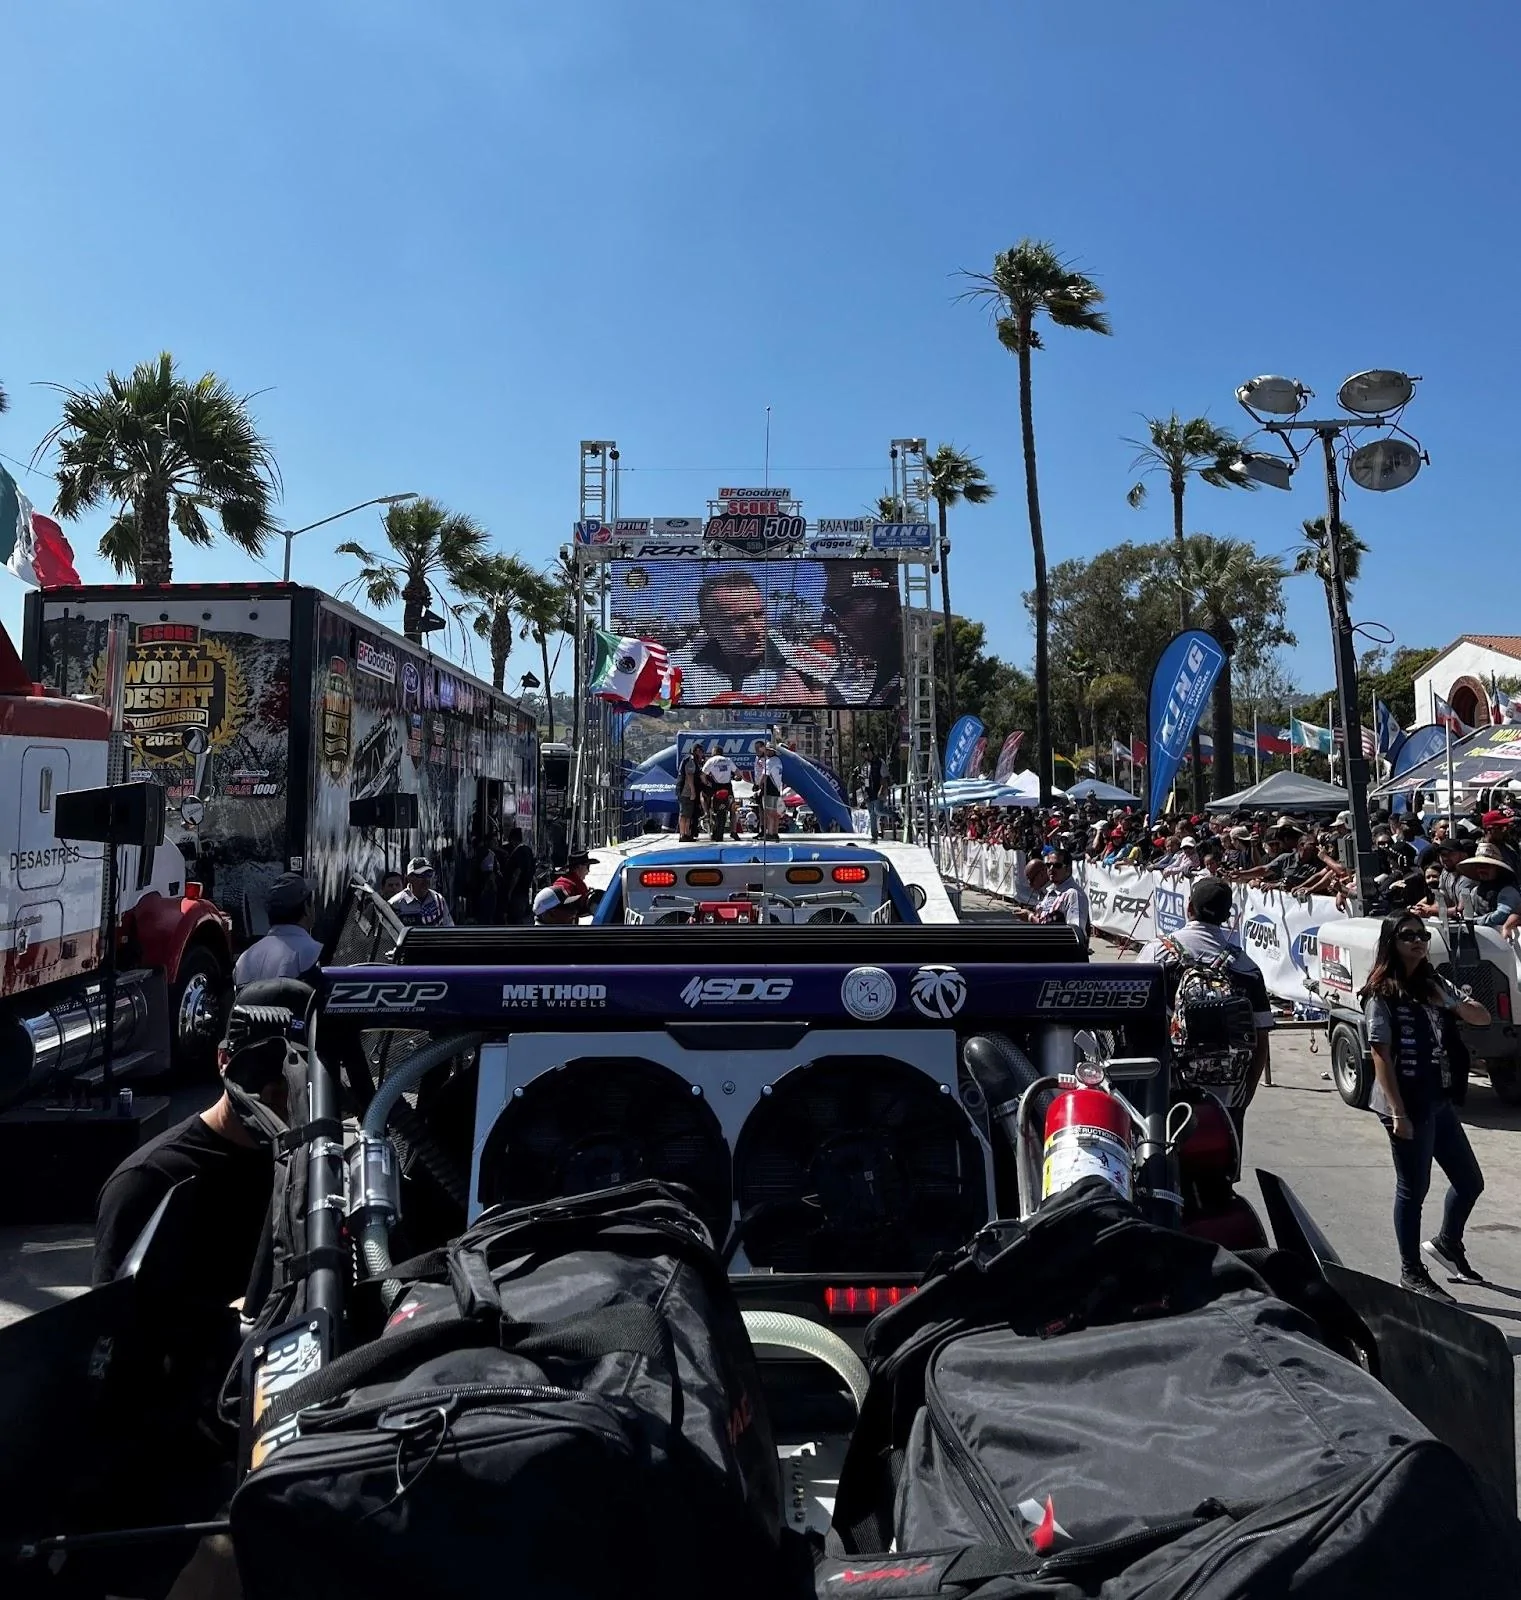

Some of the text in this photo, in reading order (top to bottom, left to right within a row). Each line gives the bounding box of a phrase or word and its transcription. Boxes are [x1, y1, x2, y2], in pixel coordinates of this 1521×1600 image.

[720, 488, 789, 497] BFGoodrich
[728, 500, 779, 515] SCORE
[577, 520, 601, 545] VP
[616, 522, 648, 530] OPTIMA
[706, 517, 803, 539] BAJA 500
[874, 526, 929, 537] KING
[637, 546, 700, 557] RZR
[142, 626, 194, 641] SCORE
[360, 643, 395, 674] BFGoodrich
[125, 660, 215, 684] WORLD
[124, 687, 214, 709] DESERT
[1162, 644, 1204, 745] KING
[130, 711, 205, 729] HAMPIONSHIP
[145, 732, 183, 746] 2023
[252, 784, 277, 795] 1000
[10, 846, 80, 871] DESASTRES
[1113, 894, 1151, 918] RZR
[326, 981, 449, 1007] ZRP
[502, 984, 607, 999] METHOD
[701, 978, 794, 1000] SDG
[1048, 980, 1101, 991] EL CAJON
[502, 1000, 606, 1008] RACE WHEELS
[1037, 982, 1149, 1008] HOBBIES
[1066, 1126, 1121, 1144] STRUCTIONS
